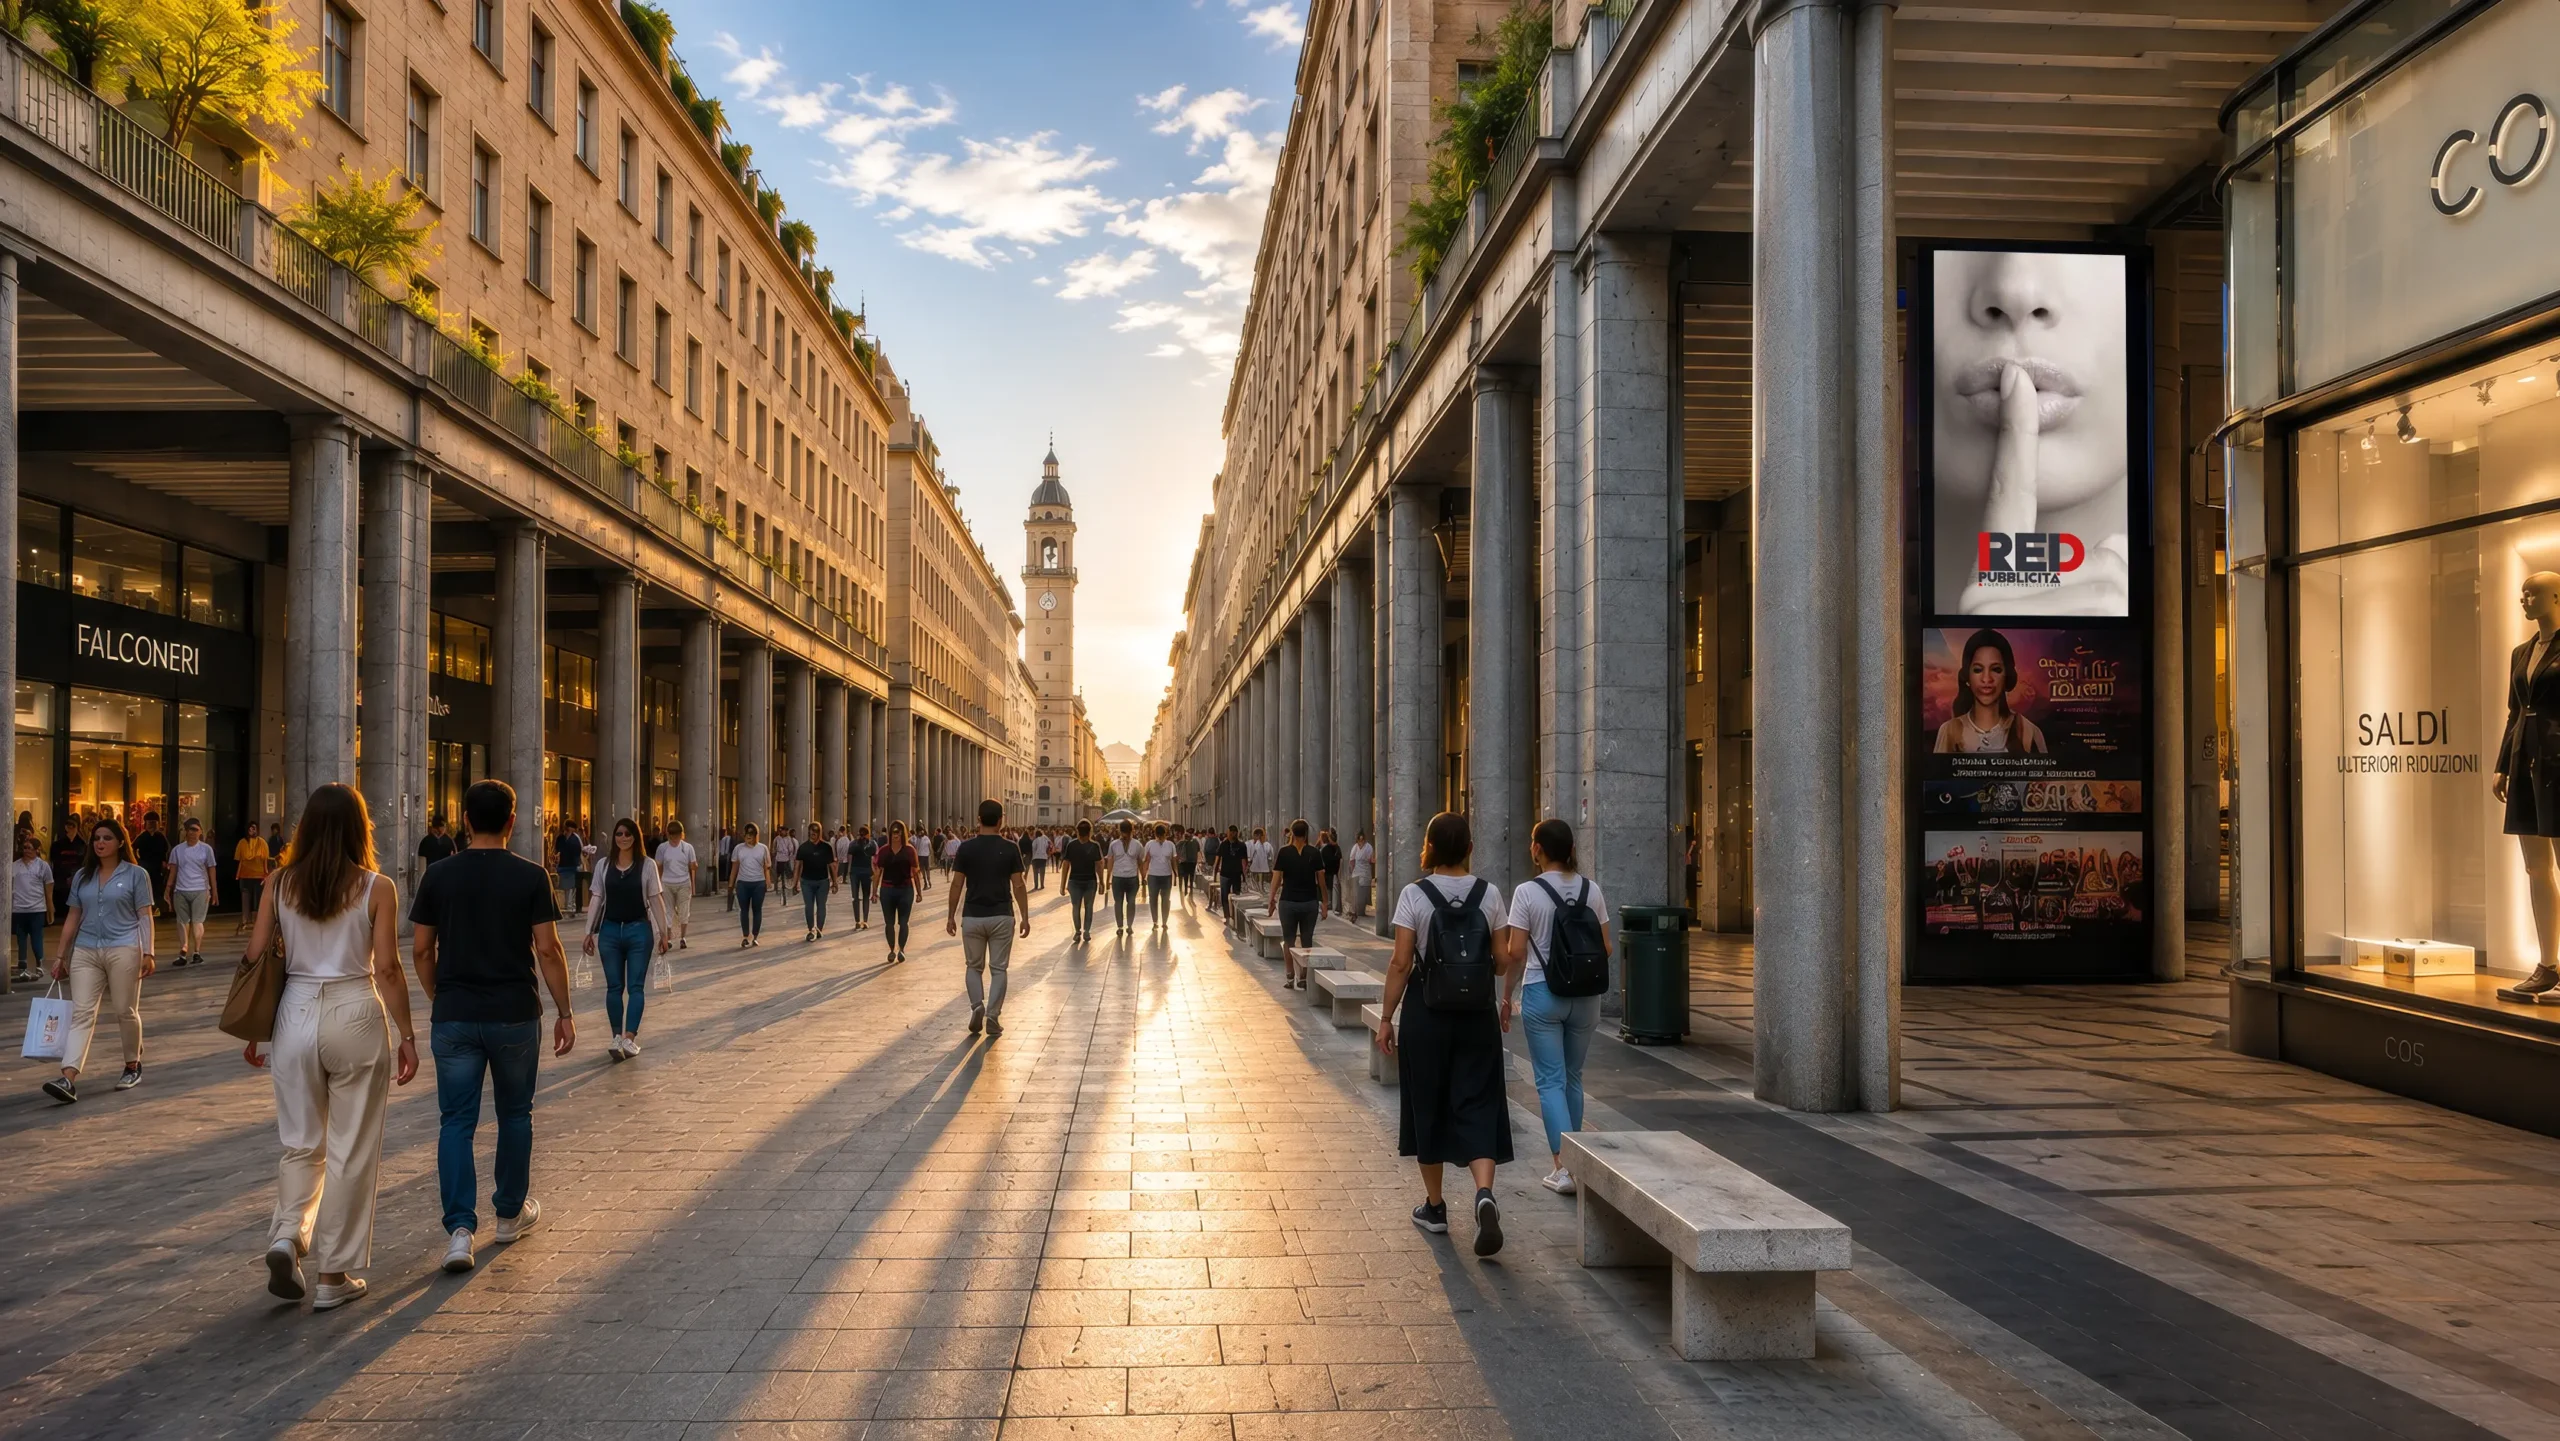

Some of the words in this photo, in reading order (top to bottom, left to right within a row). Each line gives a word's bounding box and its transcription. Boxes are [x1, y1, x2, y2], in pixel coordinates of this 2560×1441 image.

[1978, 531, 2085, 572] RED
[78, 623, 199, 675] FALCONERI
[2406, 754, 2478, 773] RIDUZIONI
[2385, 1036, 2425, 1067] COS
